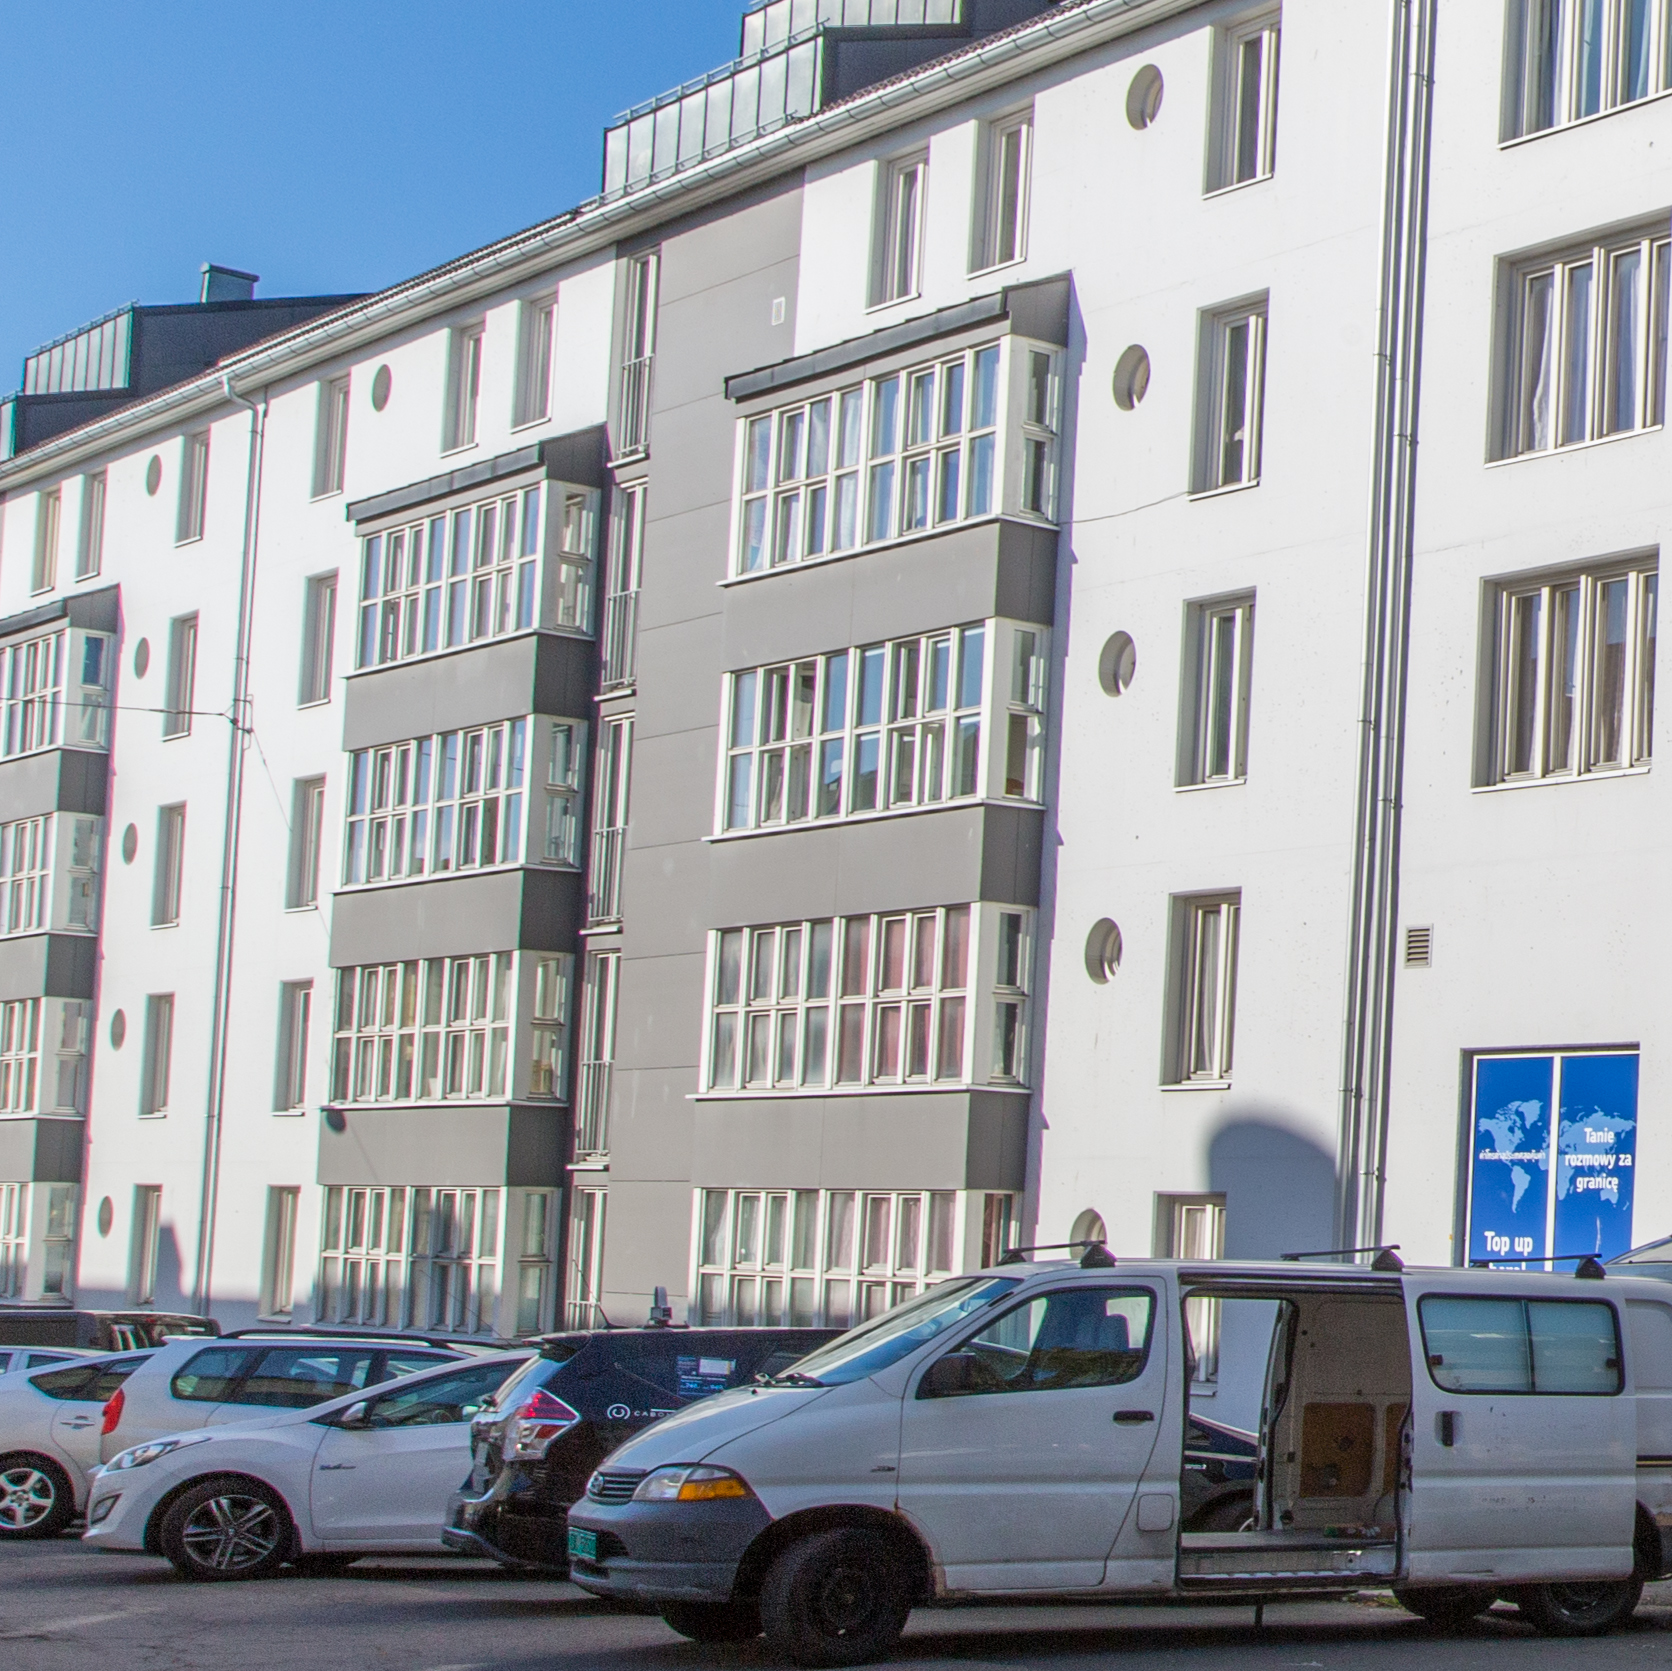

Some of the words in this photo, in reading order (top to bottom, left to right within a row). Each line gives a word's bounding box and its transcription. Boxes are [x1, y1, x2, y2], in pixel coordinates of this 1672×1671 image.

[1584, 1127, 1615, 1143] Tanie
[1564, 1153, 1616, 1169] rozmowy
[1618, 1153, 1632, 1166] za
[1576, 1174, 1619, 1192] granicę
[1484, 1231, 1510, 1256] Top
[1514, 1236, 1533, 1256] up
